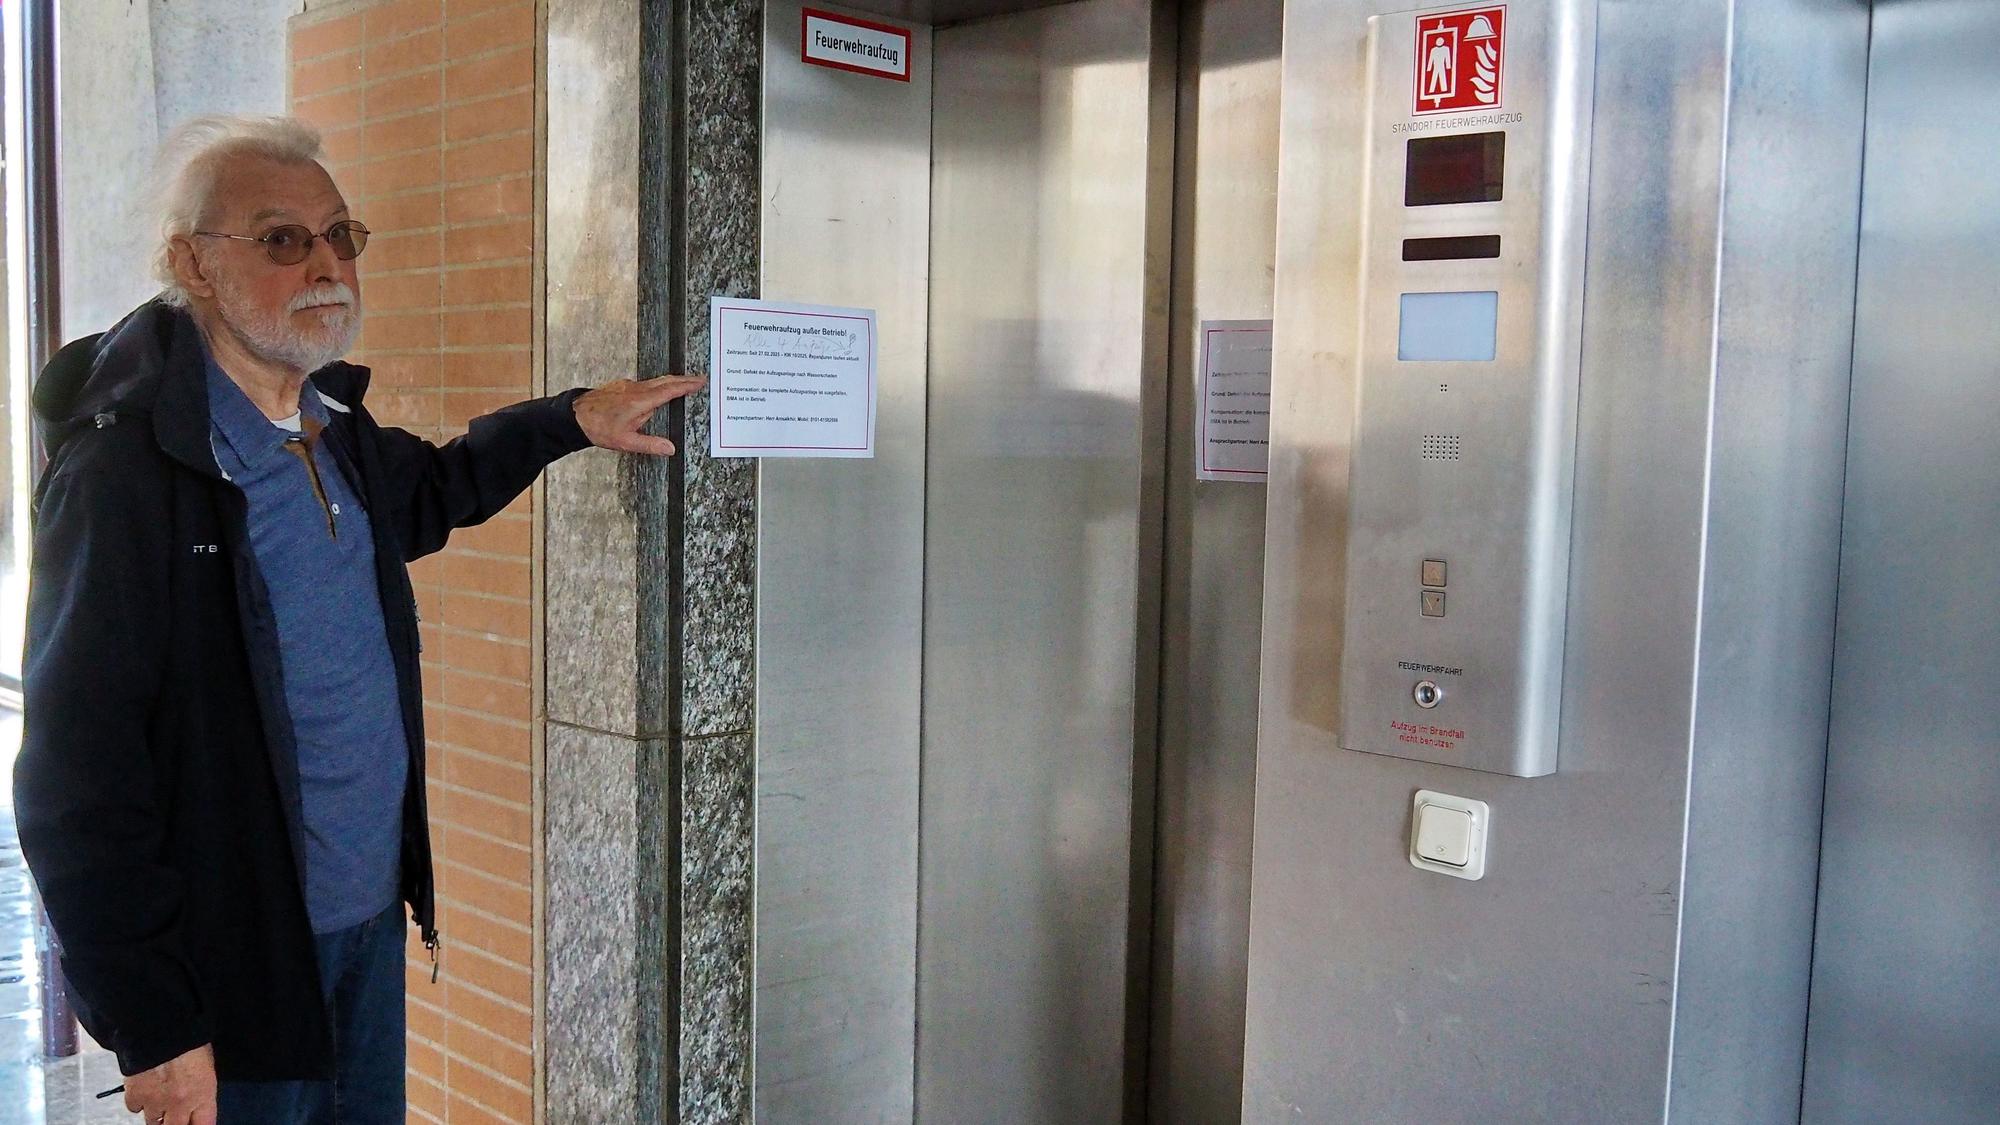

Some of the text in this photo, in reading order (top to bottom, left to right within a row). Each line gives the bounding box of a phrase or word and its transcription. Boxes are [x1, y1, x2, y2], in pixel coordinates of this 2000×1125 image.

[816, 30, 898, 66] Feuerwehraufzug
[1392, 112, 1522, 134] STANDORT FEUERWEHRAUFZUG
[744, 322, 847, 337] Feuerwehraufzug außer Betrieb!
[1398, 661, 1463, 676] FEUERWEHRFAHRT
[1391, 721, 1464, 739] Aufzug im Brandfall
[1399, 734, 1454, 749] nicht benutzen
